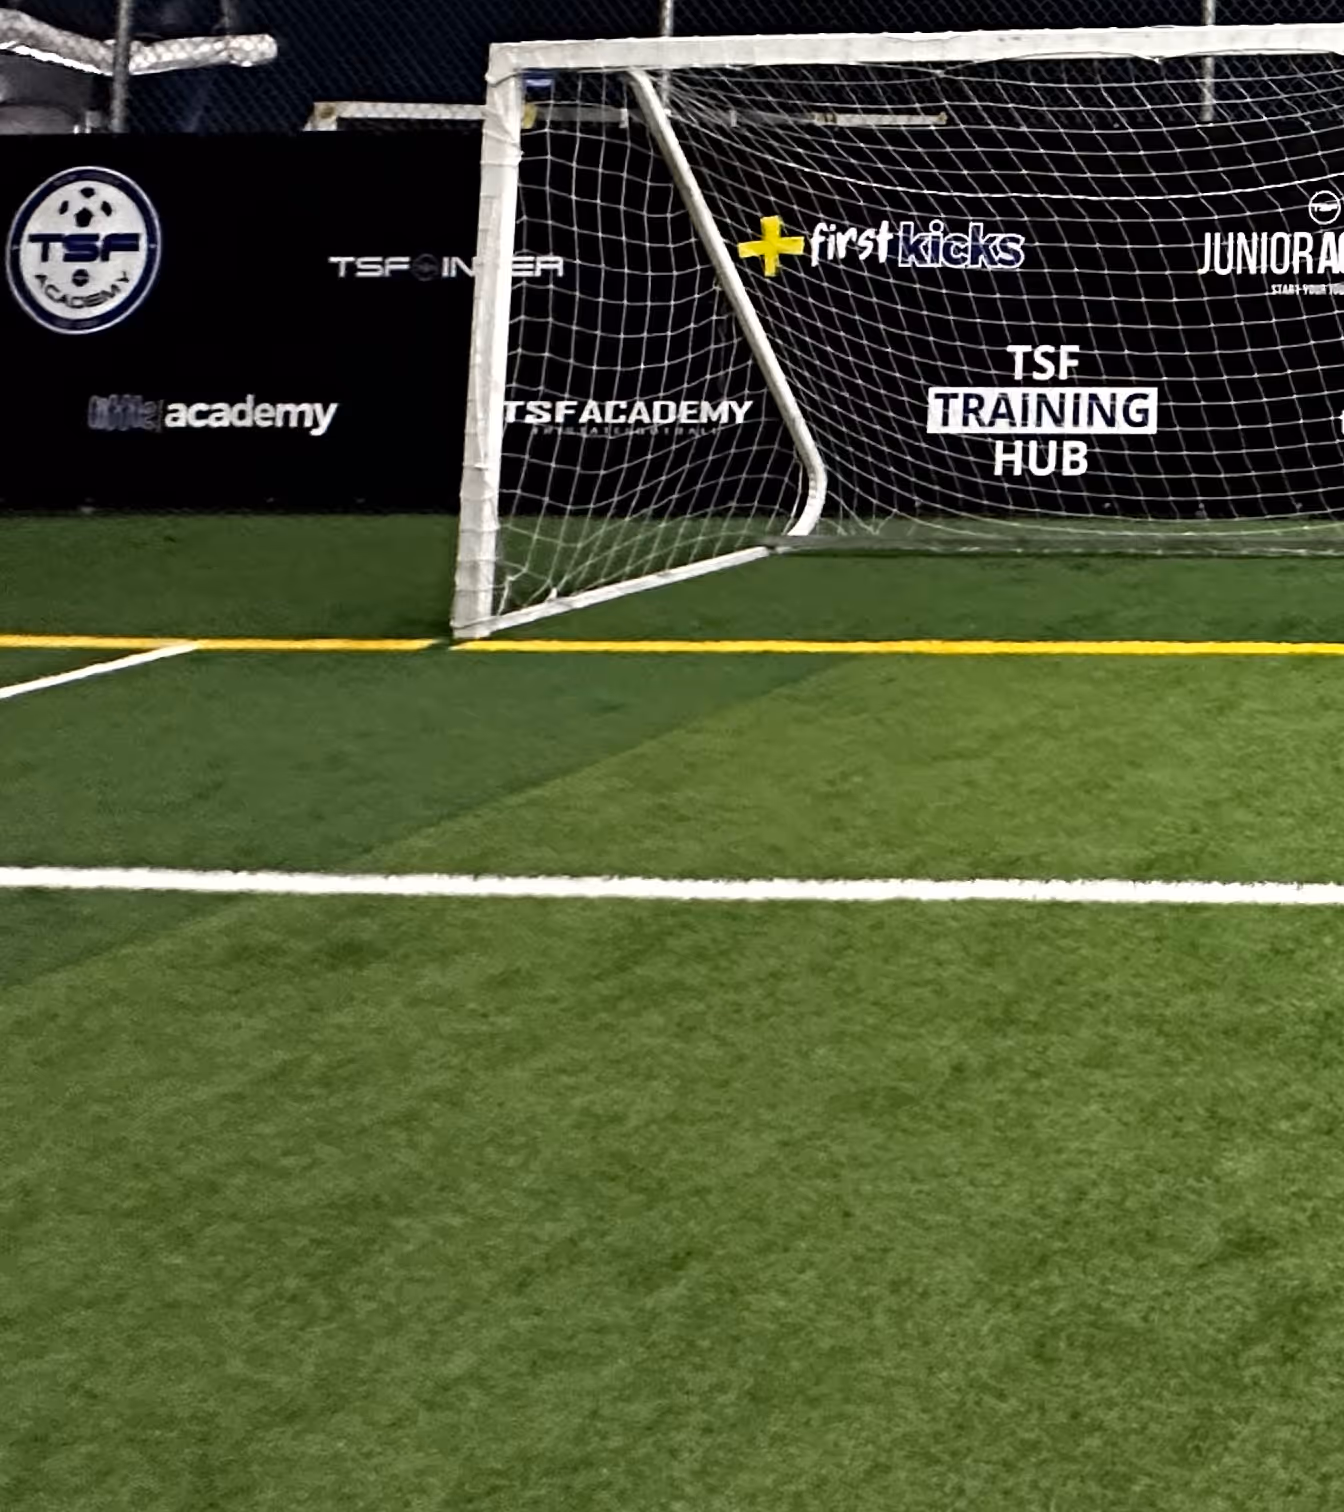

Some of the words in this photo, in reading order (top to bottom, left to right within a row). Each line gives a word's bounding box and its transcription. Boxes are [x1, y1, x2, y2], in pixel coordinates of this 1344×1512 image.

[28, 232, 140, 263] TSF
[1197, 231, 1314, 275] JUNIOR
[328, 256, 411, 278] TSF
[441, 255, 565, 278] INER
[34, 270, 129, 309] ACADEMY
[1005, 344, 1081, 381] TSF
[164, 393, 339, 437] academy
[934, 392, 1151, 428] TRAINING
[993, 439, 1089, 477] HUB
